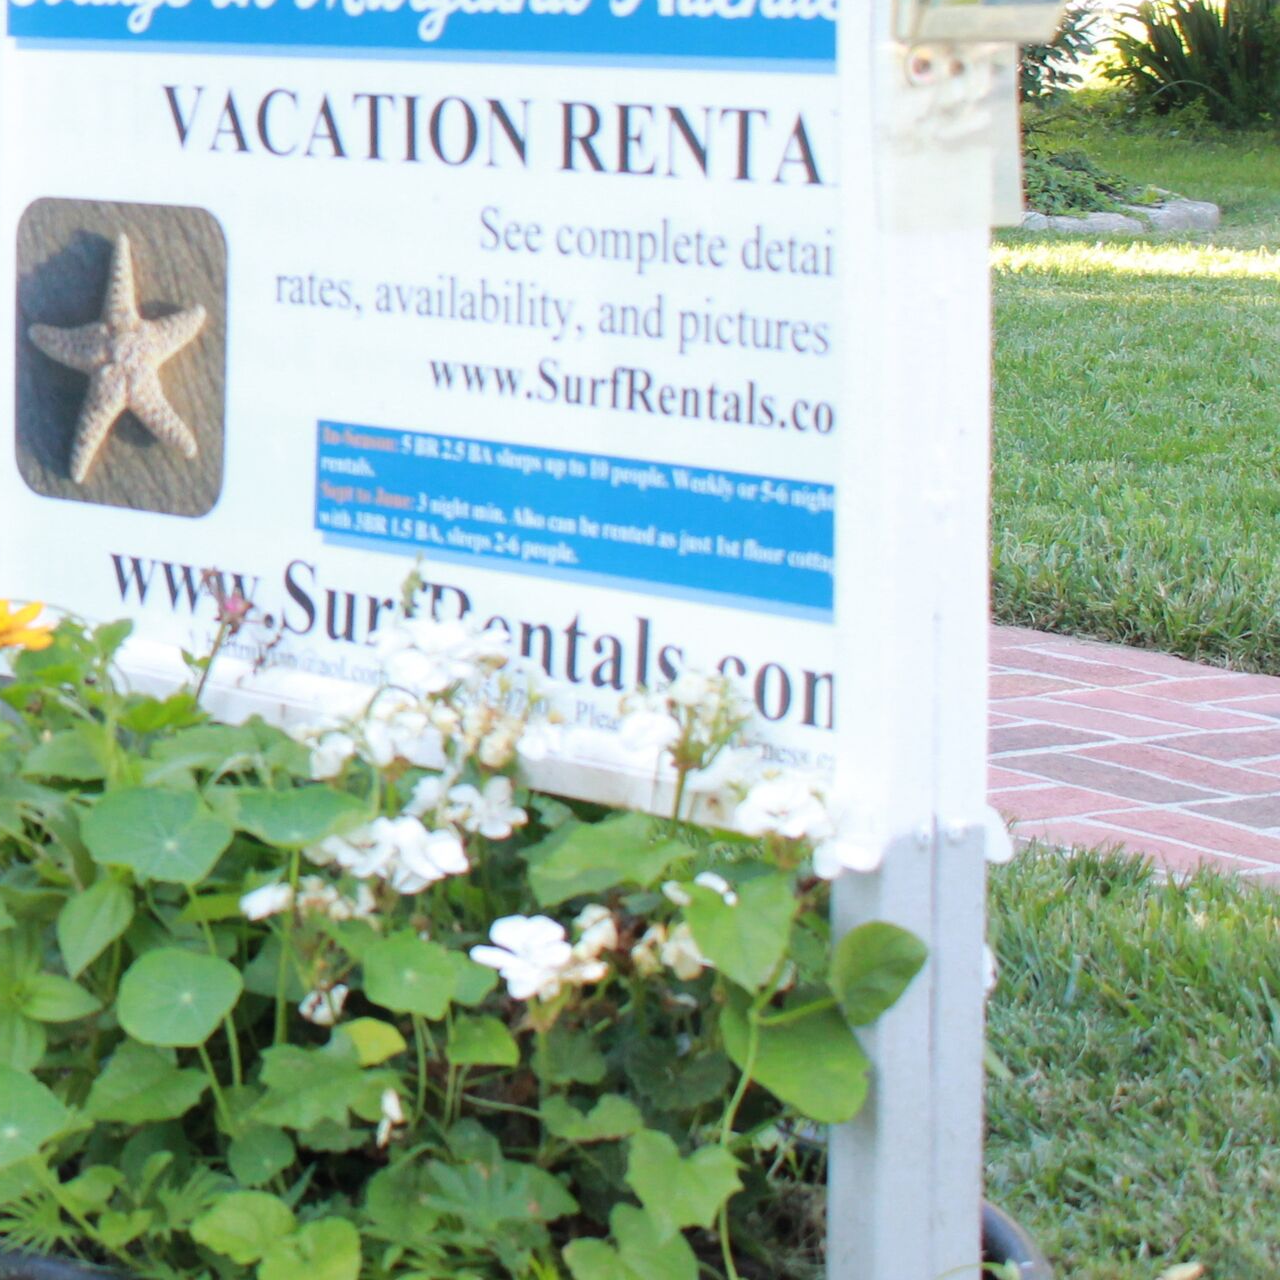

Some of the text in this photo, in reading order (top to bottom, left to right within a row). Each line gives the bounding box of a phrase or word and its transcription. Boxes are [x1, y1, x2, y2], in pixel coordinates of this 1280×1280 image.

[162, 83, 837, 187] VACATION RENTA
[478, 205, 835, 277] See complete detai
[275, 272, 831, 355] rates, availability, and pictures
[428, 357, 836, 435] www.SurfRentals.co
